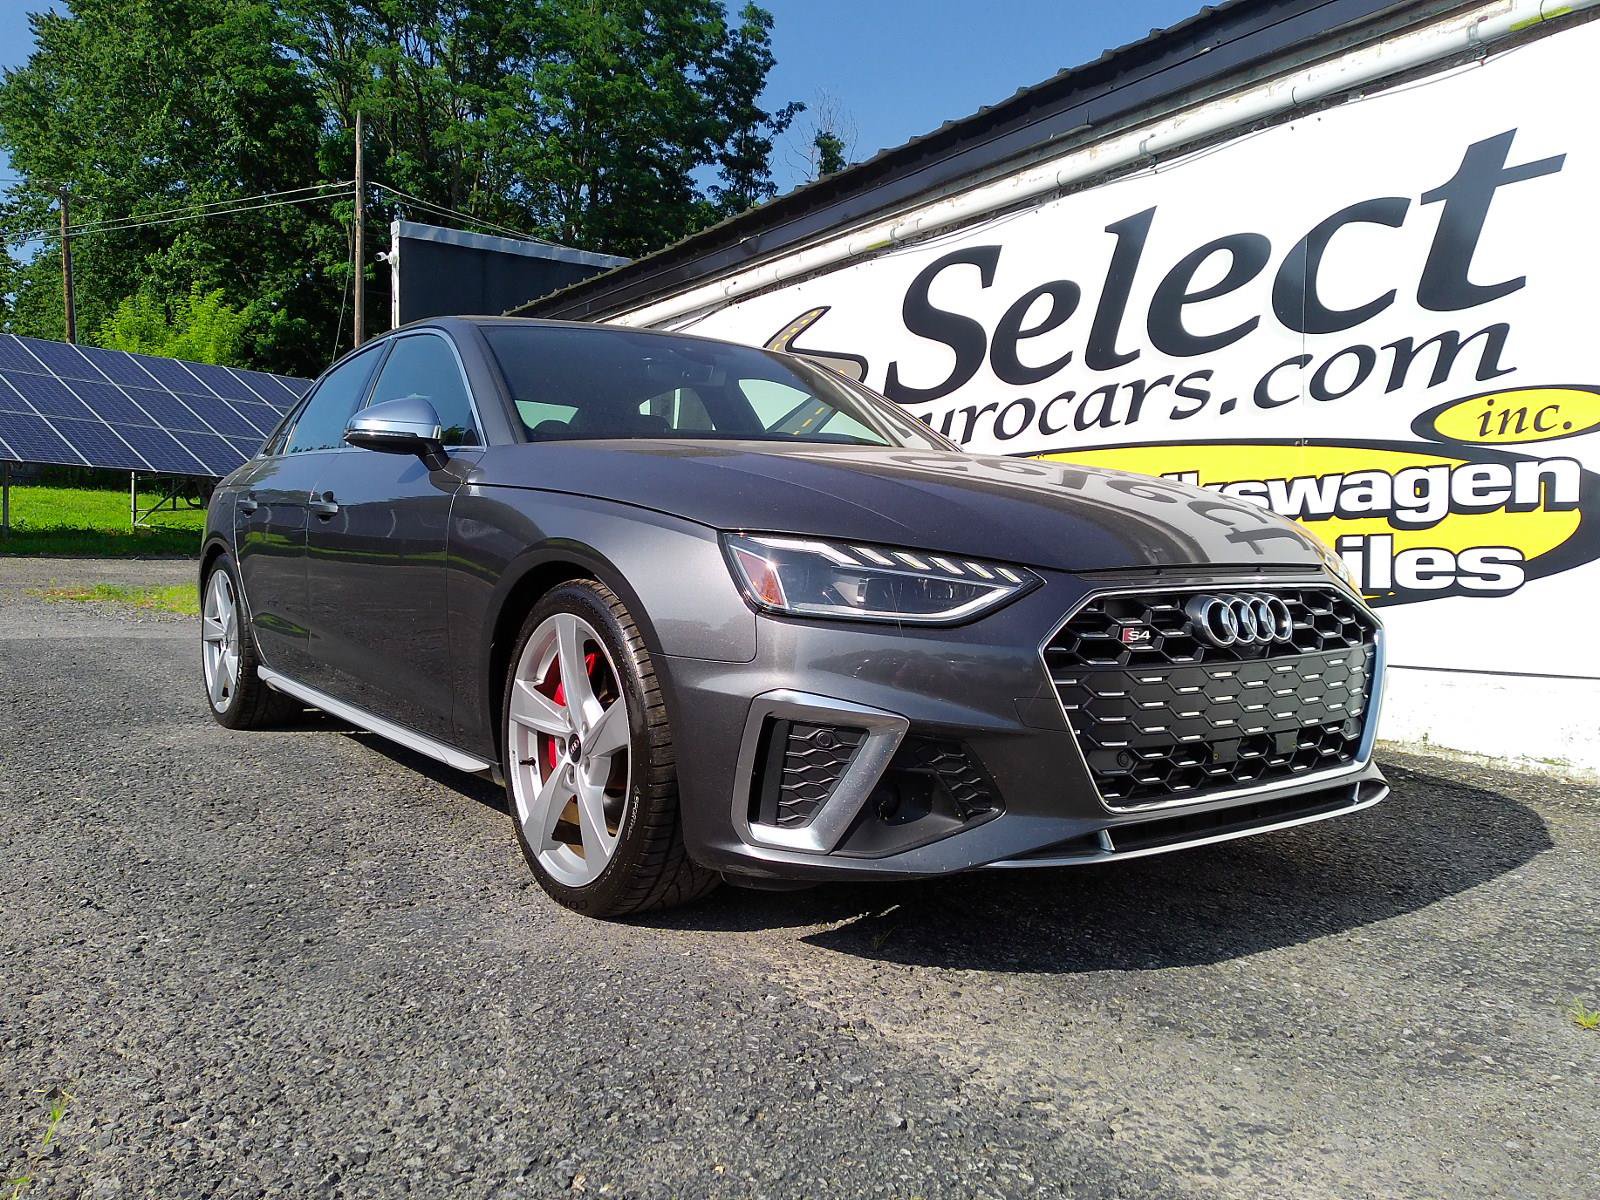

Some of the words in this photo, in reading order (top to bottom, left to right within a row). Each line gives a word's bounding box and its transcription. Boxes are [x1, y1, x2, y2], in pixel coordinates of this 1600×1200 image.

[886, 127, 1567, 405] Select
[918, 322, 1519, 445] urocars.com
[1477, 398, 1573, 437] inc.
[1338, 533, 1526, 592] iles
[1127, 630, 1151, 641] S4
